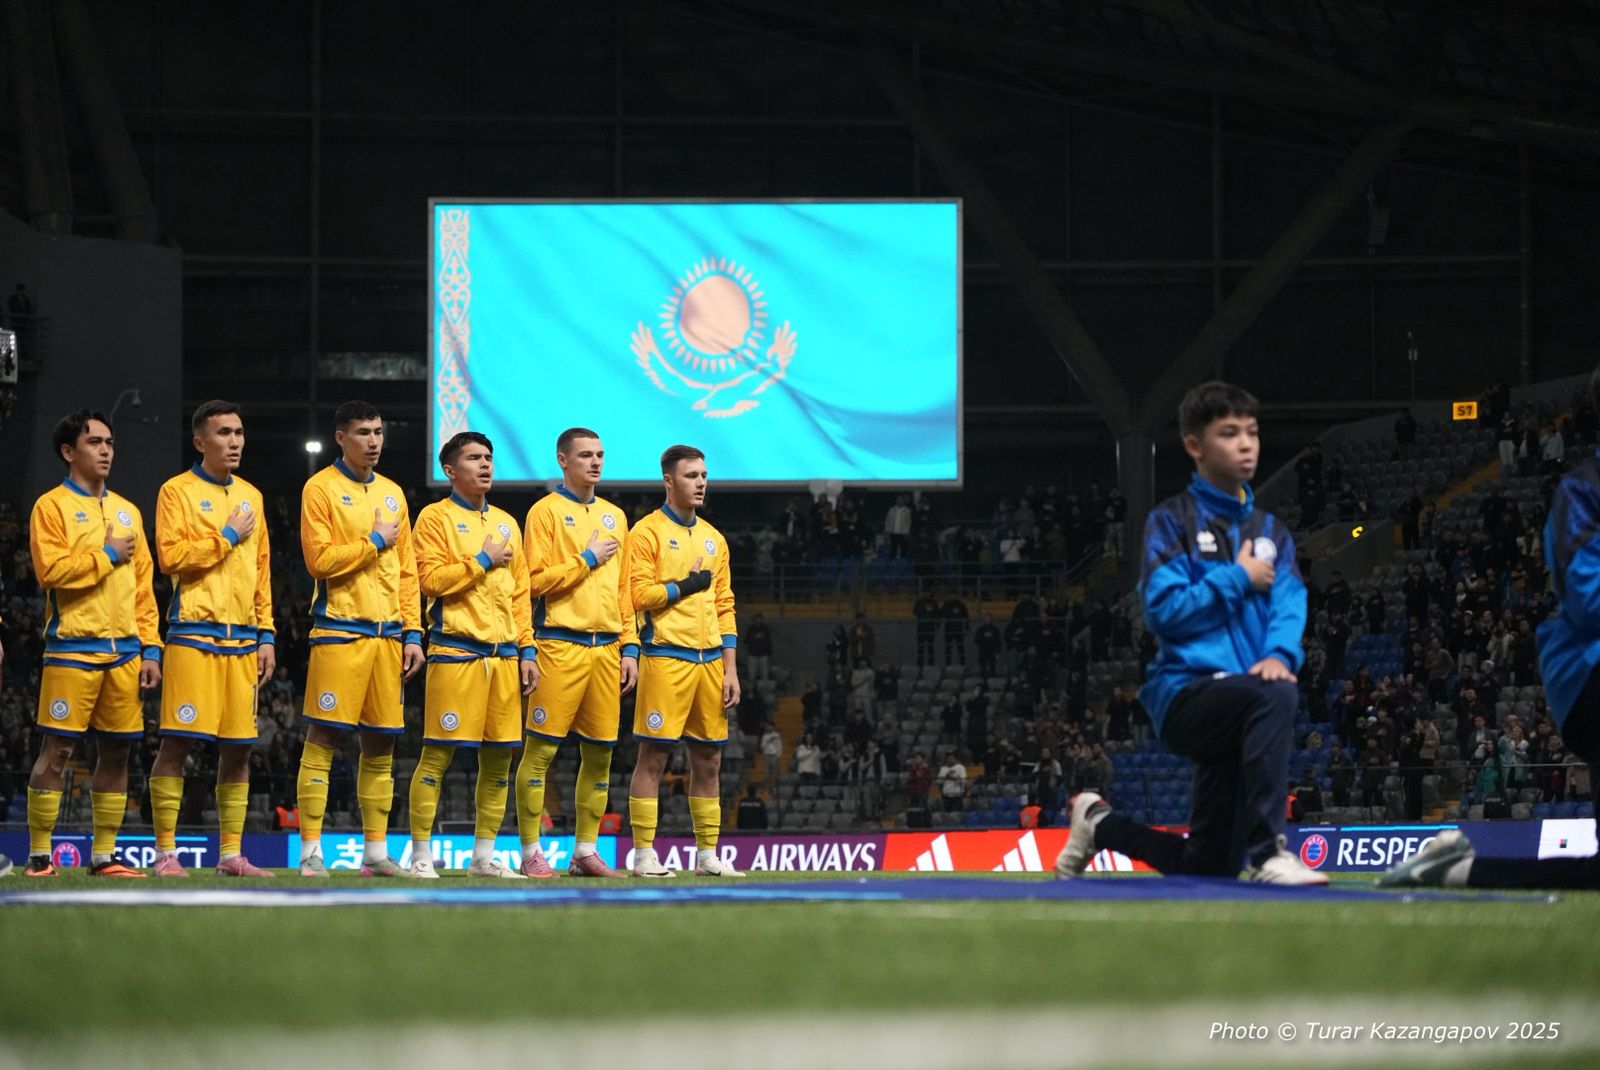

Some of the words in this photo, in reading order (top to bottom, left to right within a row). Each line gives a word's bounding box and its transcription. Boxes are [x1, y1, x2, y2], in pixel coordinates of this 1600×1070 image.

[1457, 405, 1472, 416] S7
[625, 845, 738, 870] QATR
[750, 842, 876, 871] AIRWAYS
[1336, 836, 1437, 866] RESPE
